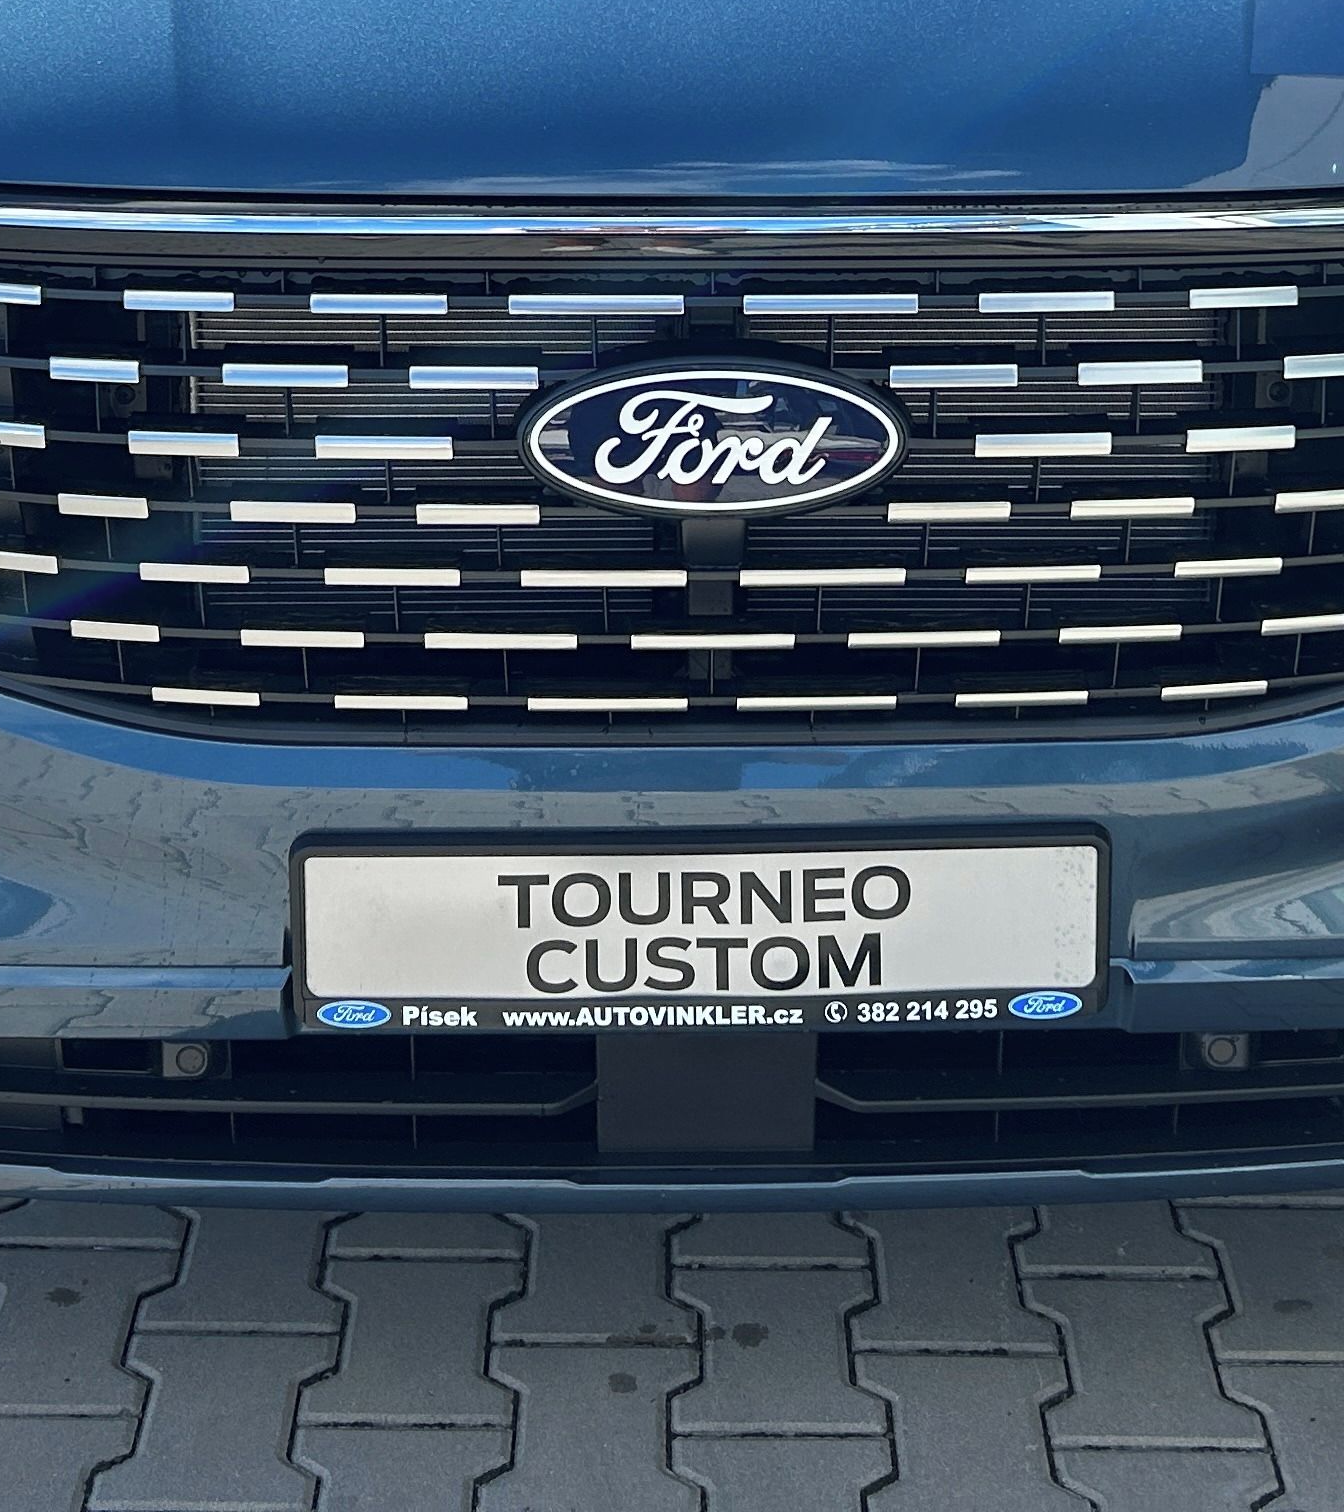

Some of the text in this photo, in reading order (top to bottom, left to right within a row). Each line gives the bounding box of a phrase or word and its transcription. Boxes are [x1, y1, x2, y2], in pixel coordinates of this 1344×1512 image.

[594, 390, 833, 485] Ford
[497, 864, 912, 929] TOURNEO
[525, 931, 882, 994] CUSTOM
[332, 995, 1067, 1027] Ford Písek www.AUTOVINKLER.cz 382 214 295 Ford
